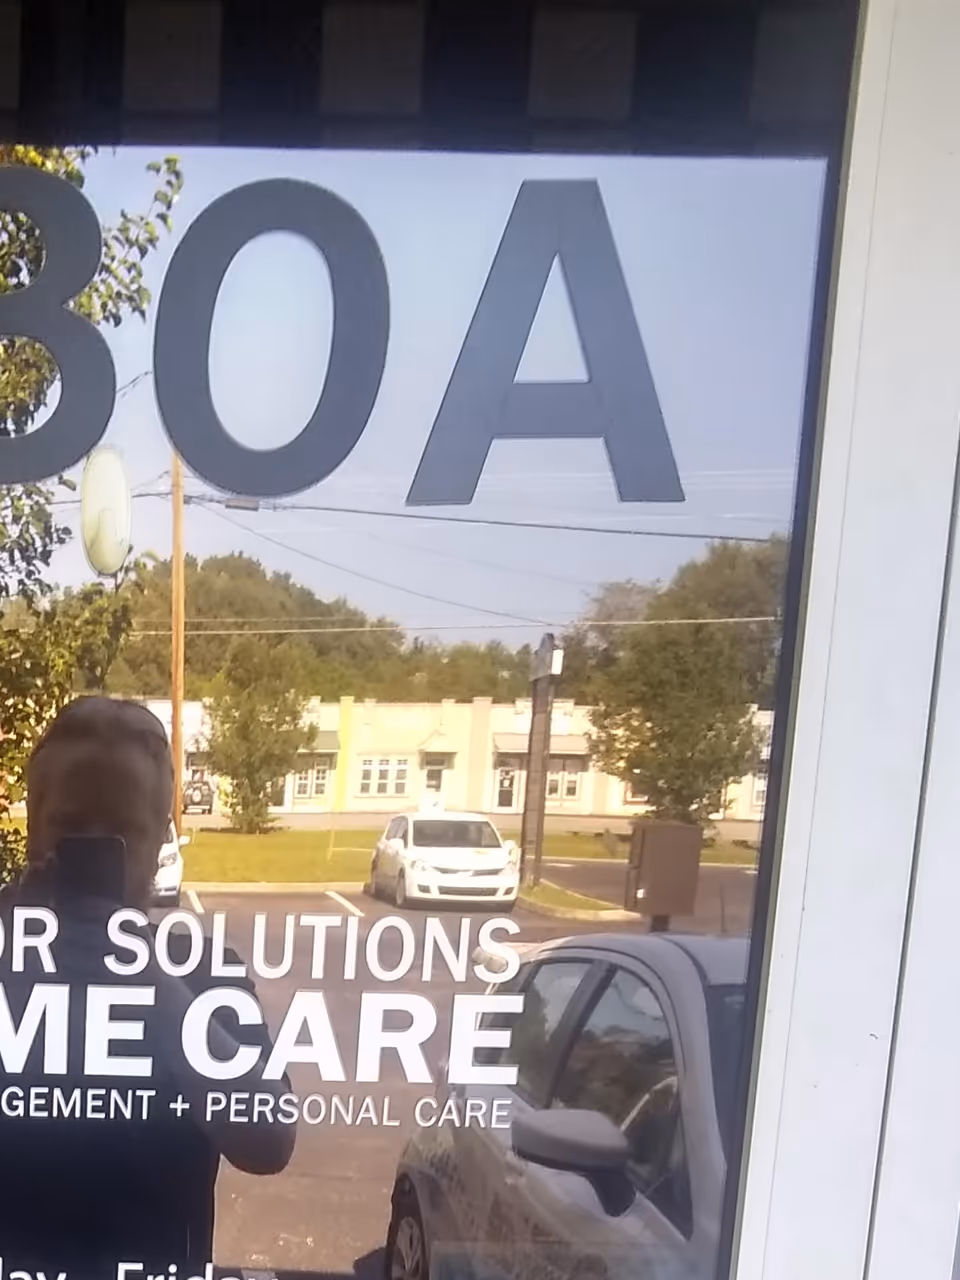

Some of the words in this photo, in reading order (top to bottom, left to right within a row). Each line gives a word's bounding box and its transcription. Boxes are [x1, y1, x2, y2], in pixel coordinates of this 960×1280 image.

[103, 907, 522, 984] SOLUTIONS
[181, 985, 525, 1086] CARE
[205, 1091, 401, 1127] PERSONAL
[413, 1096, 513, 1130] CARE
